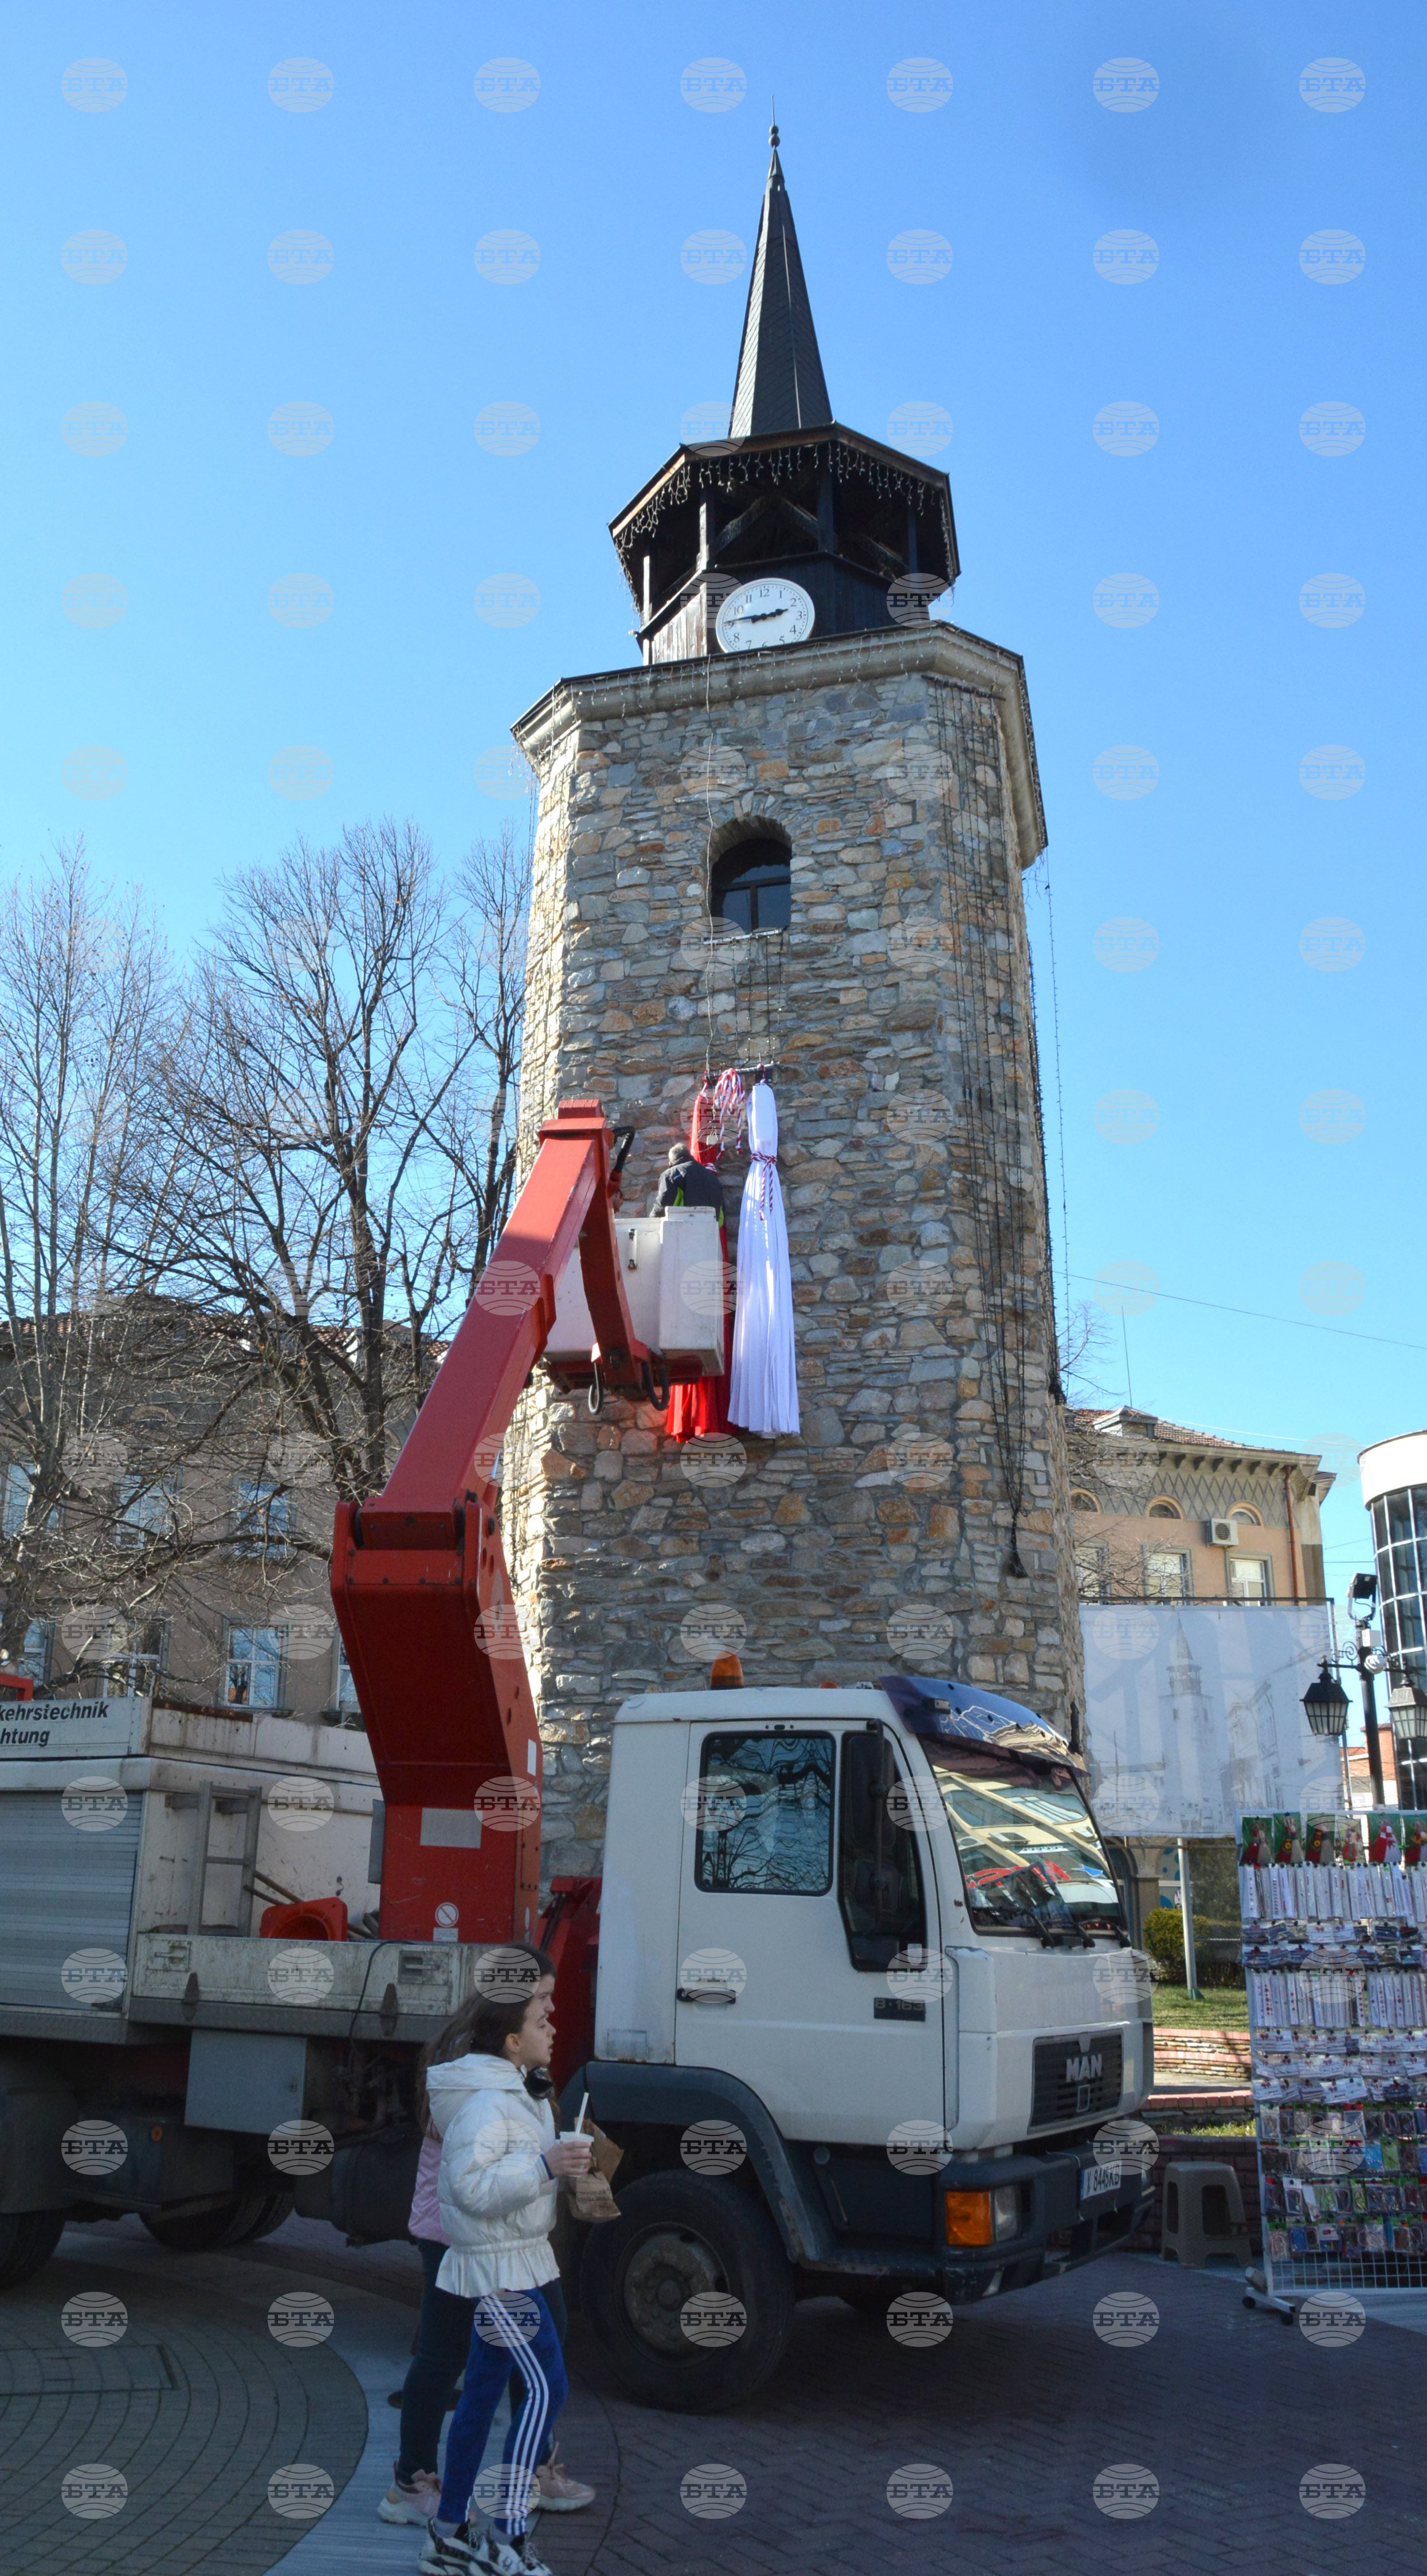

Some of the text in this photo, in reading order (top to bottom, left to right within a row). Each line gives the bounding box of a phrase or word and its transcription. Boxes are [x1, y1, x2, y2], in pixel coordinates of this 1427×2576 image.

[759, 588, 770, 598] 12
[779, 590, 782, 598] 1
[746, 594, 752, 603] 11
[790, 598, 797, 607] 2
[734, 605, 743, 615] 10
[796, 611, 802, 621] 3
[728, 621, 734, 629] 9
[789, 625, 797, 634] 4
[733, 633, 740, 643] 8
[779, 636, 785, 645] 5
[746, 640, 752, 650] 7
[0, 1727, 50, 1747] htung
[1066, 2053, 1102, 2083] MAN
